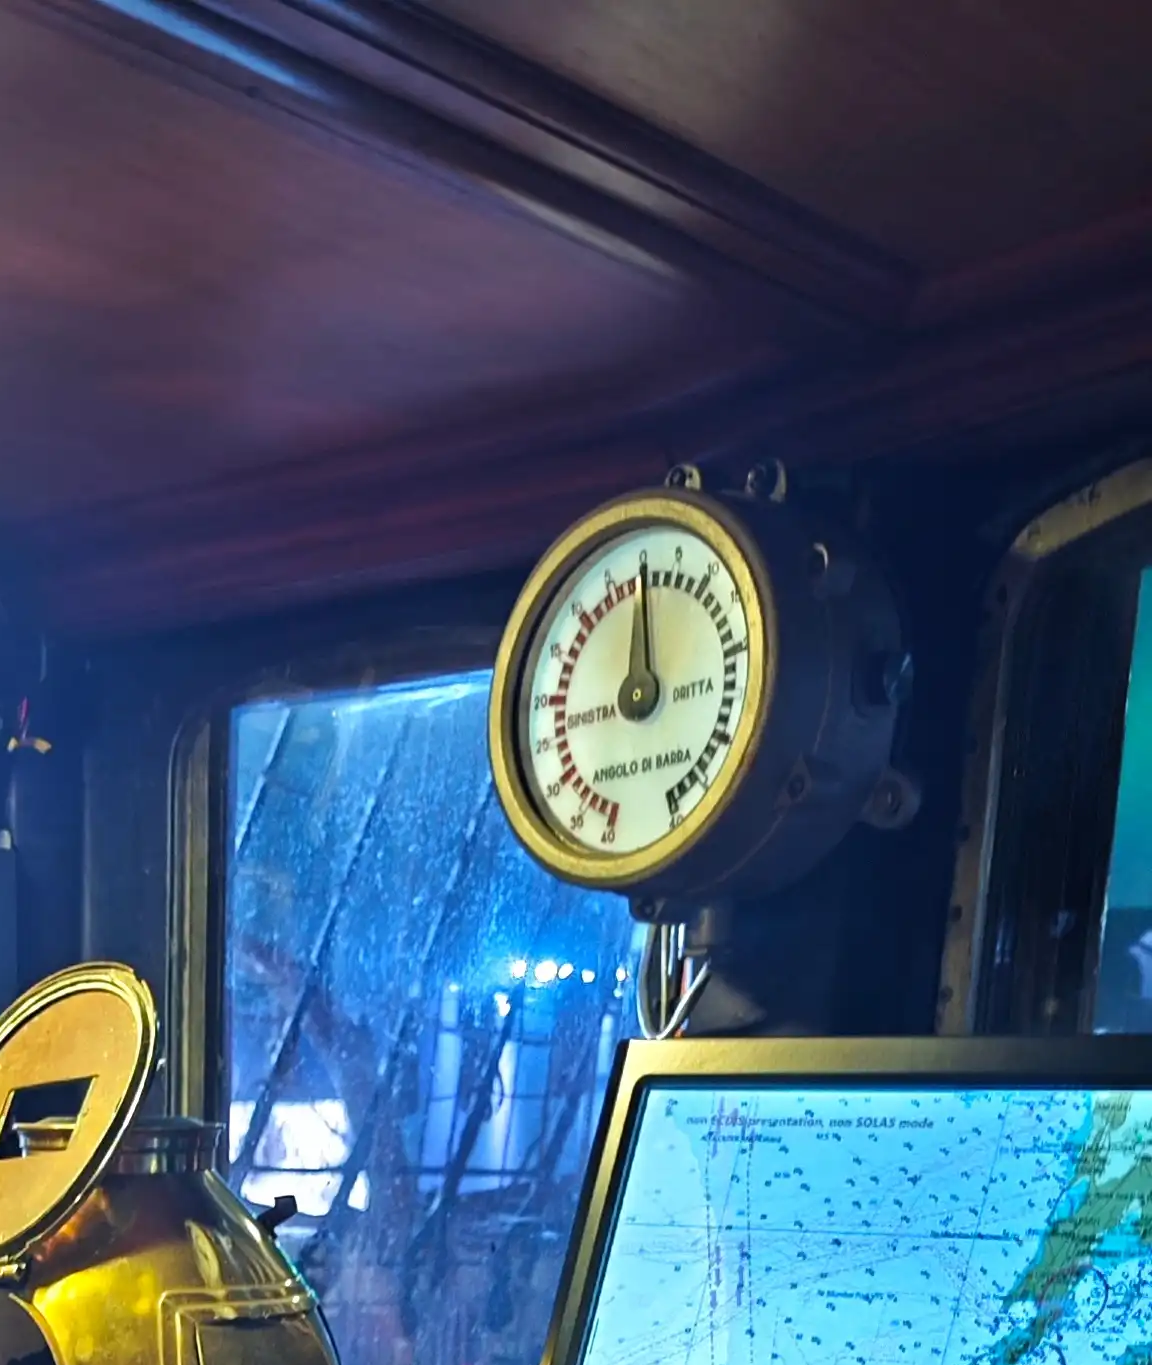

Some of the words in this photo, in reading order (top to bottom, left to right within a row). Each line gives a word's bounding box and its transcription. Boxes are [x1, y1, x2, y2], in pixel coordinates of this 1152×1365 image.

[708, 561, 720, 576] 10
[534, 694, 548, 711] 20
[566, 703, 617, 730] SINISTRA
[673, 677, 714, 704] DRITTA
[592, 761, 638, 785] ANGOLO
[641, 757, 652, 772] DI
[655, 748, 692, 770] BARRA
[546, 782, 561, 798] 30
[600, 829, 616, 844] 40
[686, 1116, 707, 1126] non
[829, 1117, 852, 1129] non
[855, 1117, 896, 1129] SOLAS
[898, 1117, 934, 1129] mode
